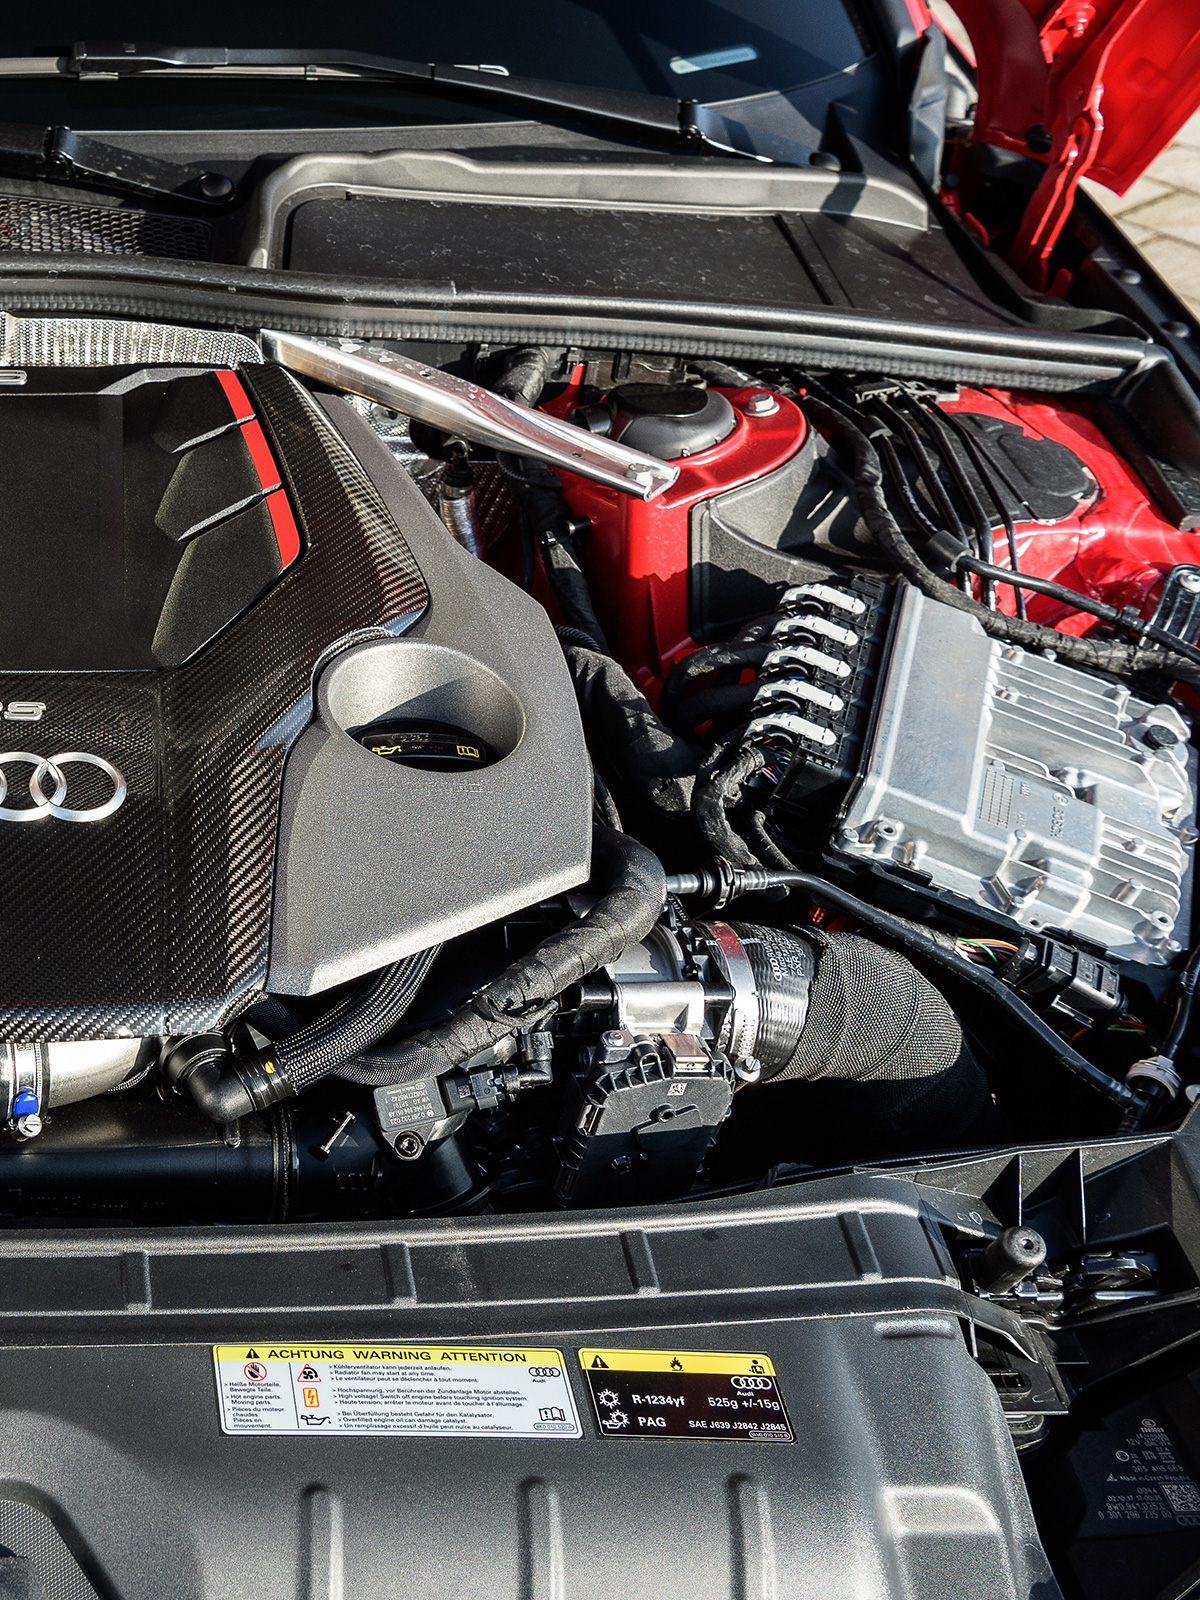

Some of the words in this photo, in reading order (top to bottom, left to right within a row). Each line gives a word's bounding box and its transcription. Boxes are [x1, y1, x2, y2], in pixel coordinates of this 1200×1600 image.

[268, 1350, 344, 1359] ACHTUNG
[353, 1351, 431, 1360] WARNING
[441, 1352, 526, 1362] ATTENTION
[632, 1394, 685, 1407] R-1234yf
[708, 1397, 738, 1410] 525g
[741, 1399, 780, 1411] +/-15g
[638, 1417, 666, 1427] PAG
[689, 1420, 707, 1428] SAE
[710, 1421, 730, 1429] J639
[733, 1422, 758, 1430] J2842
[1106, 1502, 1166, 1511] 8W0.941.035.C
[1098, 1511, 1105, 1519] 0
